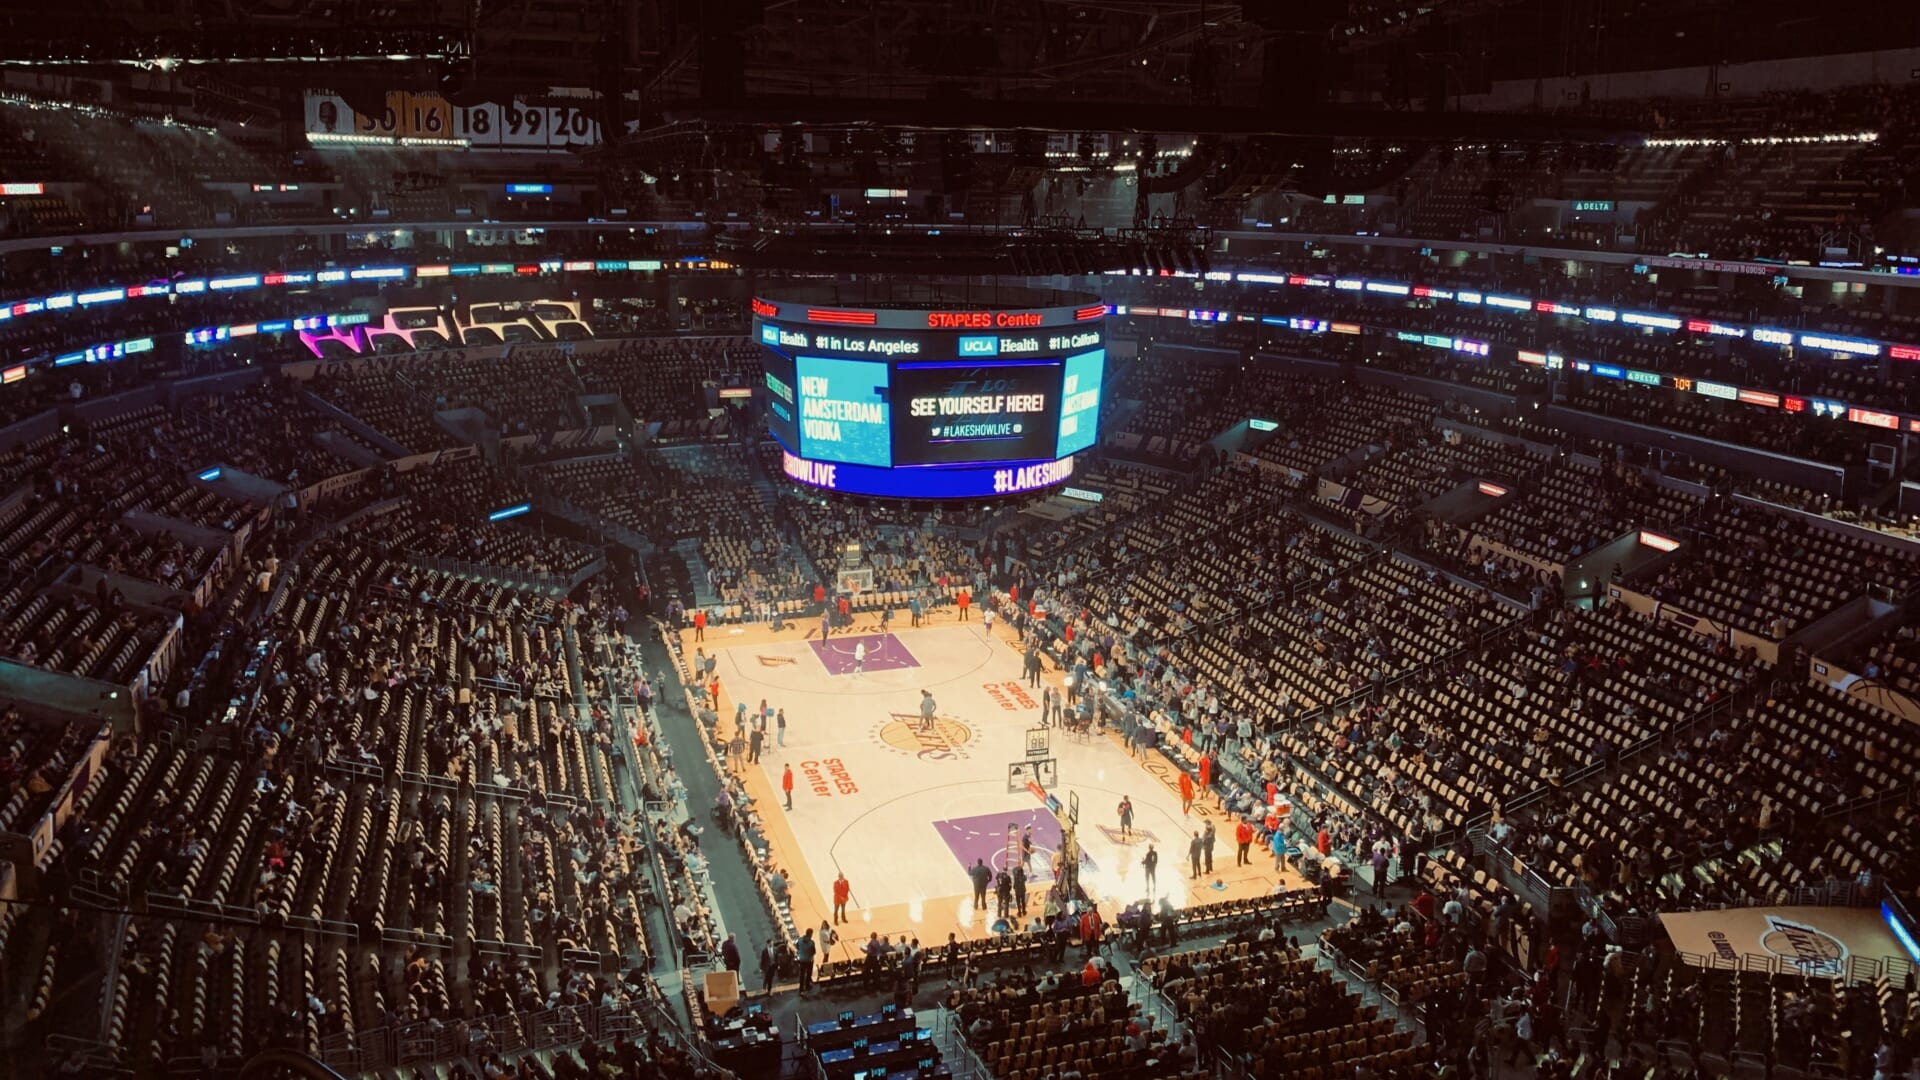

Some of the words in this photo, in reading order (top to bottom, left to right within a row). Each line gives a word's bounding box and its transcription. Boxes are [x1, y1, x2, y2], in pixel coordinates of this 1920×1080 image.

[414, 106, 443, 132] 16
[462, 107, 490, 134] 18
[507, 108, 542, 135] 99
[554, 107, 589, 136] 20
[1583, 202, 1609, 211] DELTA
[927, 313, 992, 328] STAPLES
[997, 312, 1042, 326] Center
[779, 330, 808, 348] Health
[815, 336, 829, 349] #1
[830, 336, 841, 350] in
[843, 338, 865, 351] Los
[867, 339, 919, 355] Angeles
[964, 341, 993, 352] UCLA
[1000, 338, 1039, 352] Health
[801, 376, 828, 398] NEW
[1634, 373, 1659, 383] DELTA
[911, 397, 936, 416] SEE
[938, 396, 1004, 415] YOURSELF
[1006, 394, 1044, 413] HERE!
[804, 419, 842, 442] VODKA
[943, 423, 1011, 437] #LAKESHOWLIVE
[982, 683, 1018, 711] Center
[1001, 681, 1040, 710] STAPLES
[800, 760, 832, 797] Center
[823, 758, 859, 795] STAPLES
